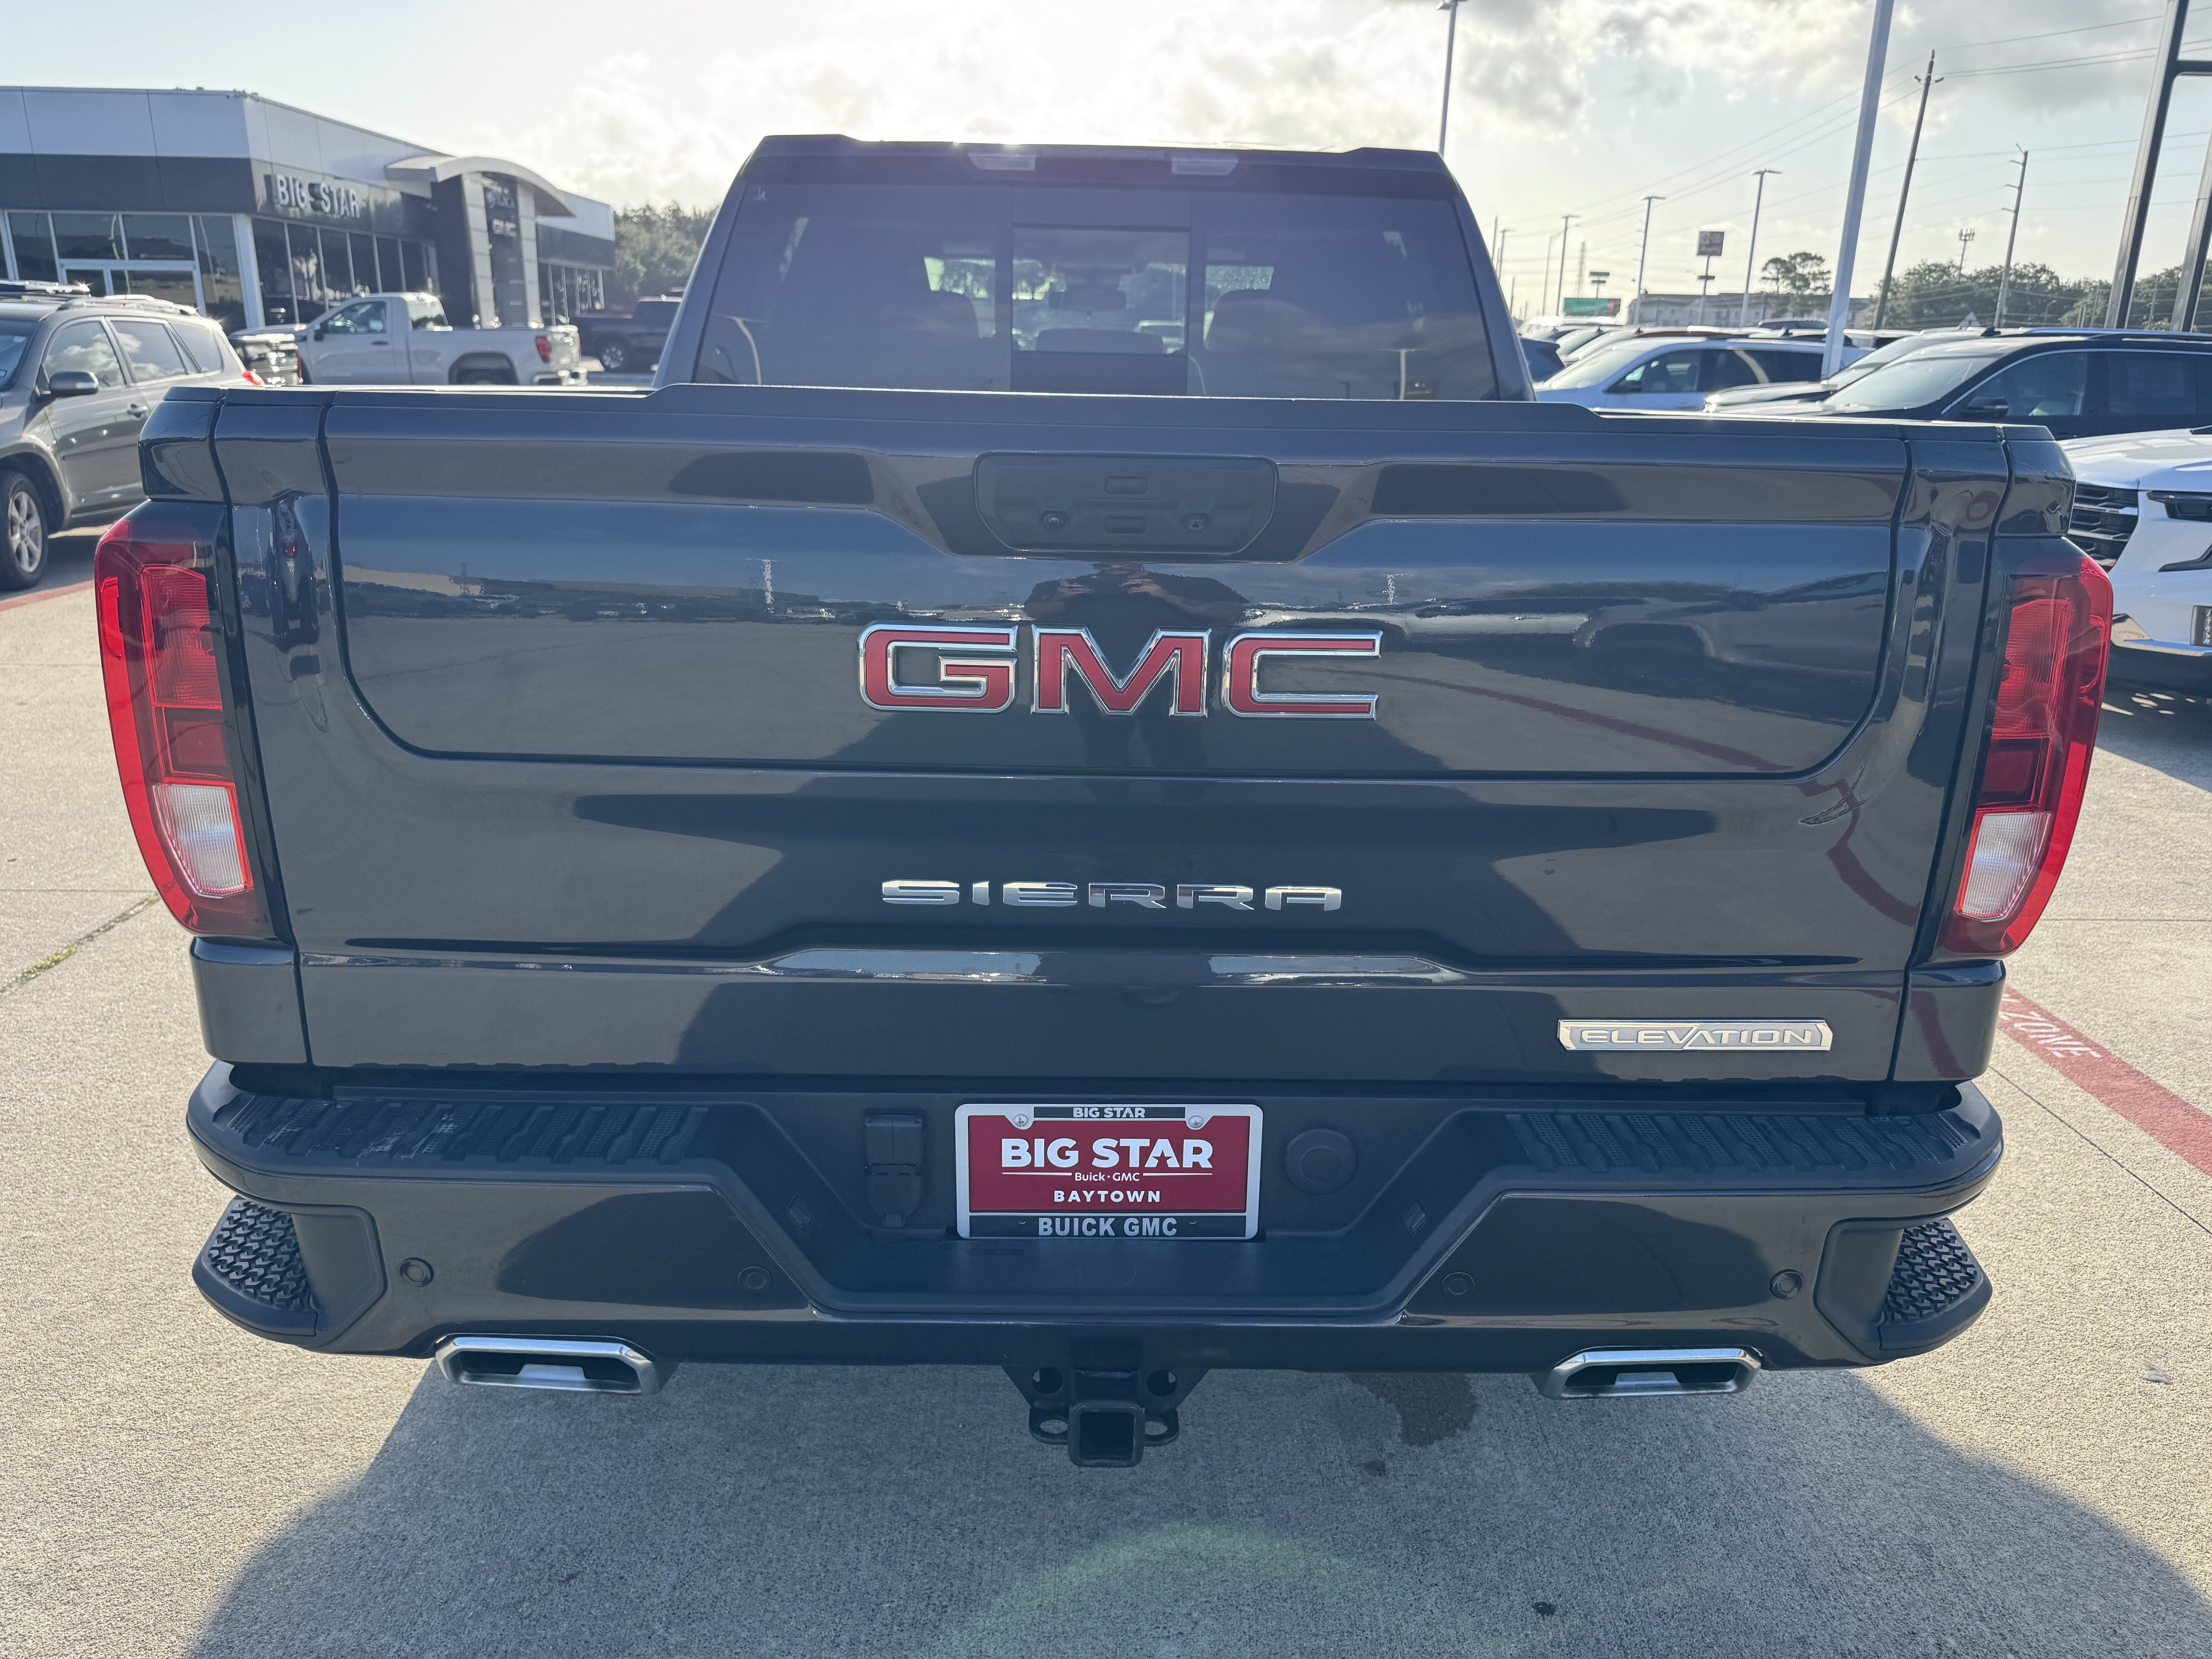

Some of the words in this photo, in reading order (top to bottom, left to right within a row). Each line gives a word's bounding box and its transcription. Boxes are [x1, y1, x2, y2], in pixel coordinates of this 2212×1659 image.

[276, 174, 307, 209] BIG
[319, 181, 360, 218] STAR
[857, 623, 1383, 720] GMC
[882, 879, 1341, 911] SIERRA
[1581, 1028, 1812, 1044] ELEVATION
[1073, 1107, 1100, 1118] BIG
[1104, 1107, 1146, 1118] STAR
[1001, 1138, 1079, 1168] BIG
[1092, 1138, 1213, 1168] STAR
[1075, 1172, 1105, 1181] Buick
[1112, 1172, 1140, 1182] GMC
[1054, 1190, 1160, 1202] BAYTOWN
[1038, 1218, 1115, 1236] BUICK
[1123, 1218, 1177, 1237] GMC
